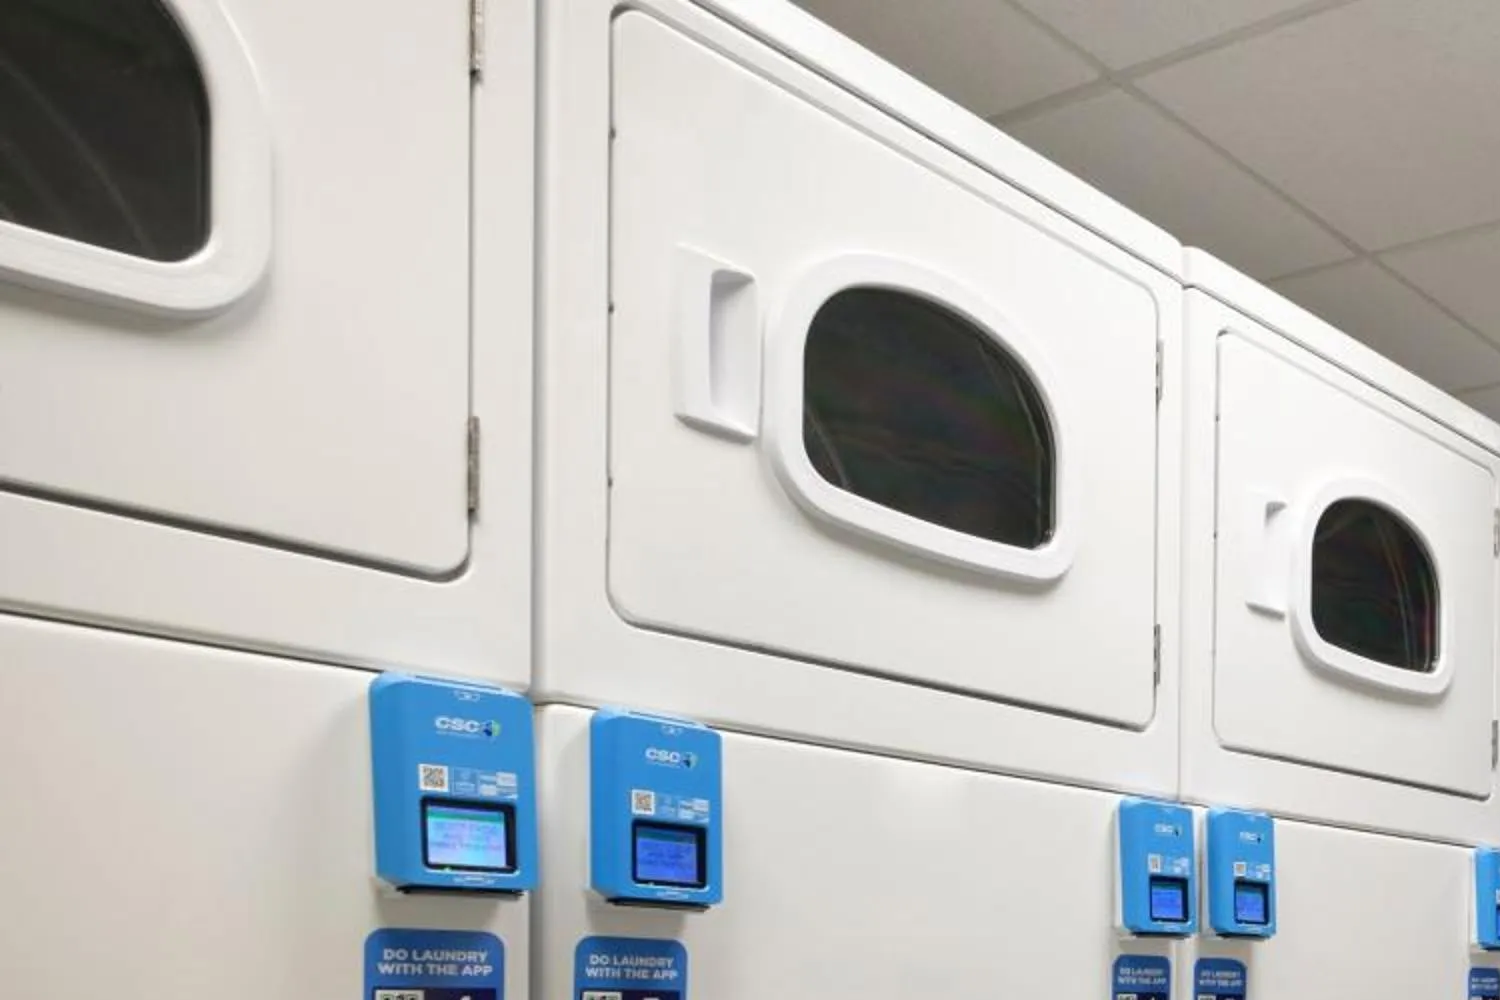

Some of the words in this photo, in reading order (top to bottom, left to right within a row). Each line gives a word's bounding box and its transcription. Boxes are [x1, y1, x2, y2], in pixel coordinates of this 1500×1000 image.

[434, 716, 481, 733] CSC
[645, 748, 681, 763] CSC
[383, 948, 409, 961] DO
[412, 949, 488, 963] LAUNDRY
[589, 954, 609, 966] DO
[613, 955, 674, 968] LAUNDRY
[377, 962, 422, 976] WITH
[427, 963, 458, 976] THE
[461, 964, 493, 977] APP
[585, 967, 620, 978] WITH
[624, 968, 650, 979] THE
[653, 969, 679, 980] APP
